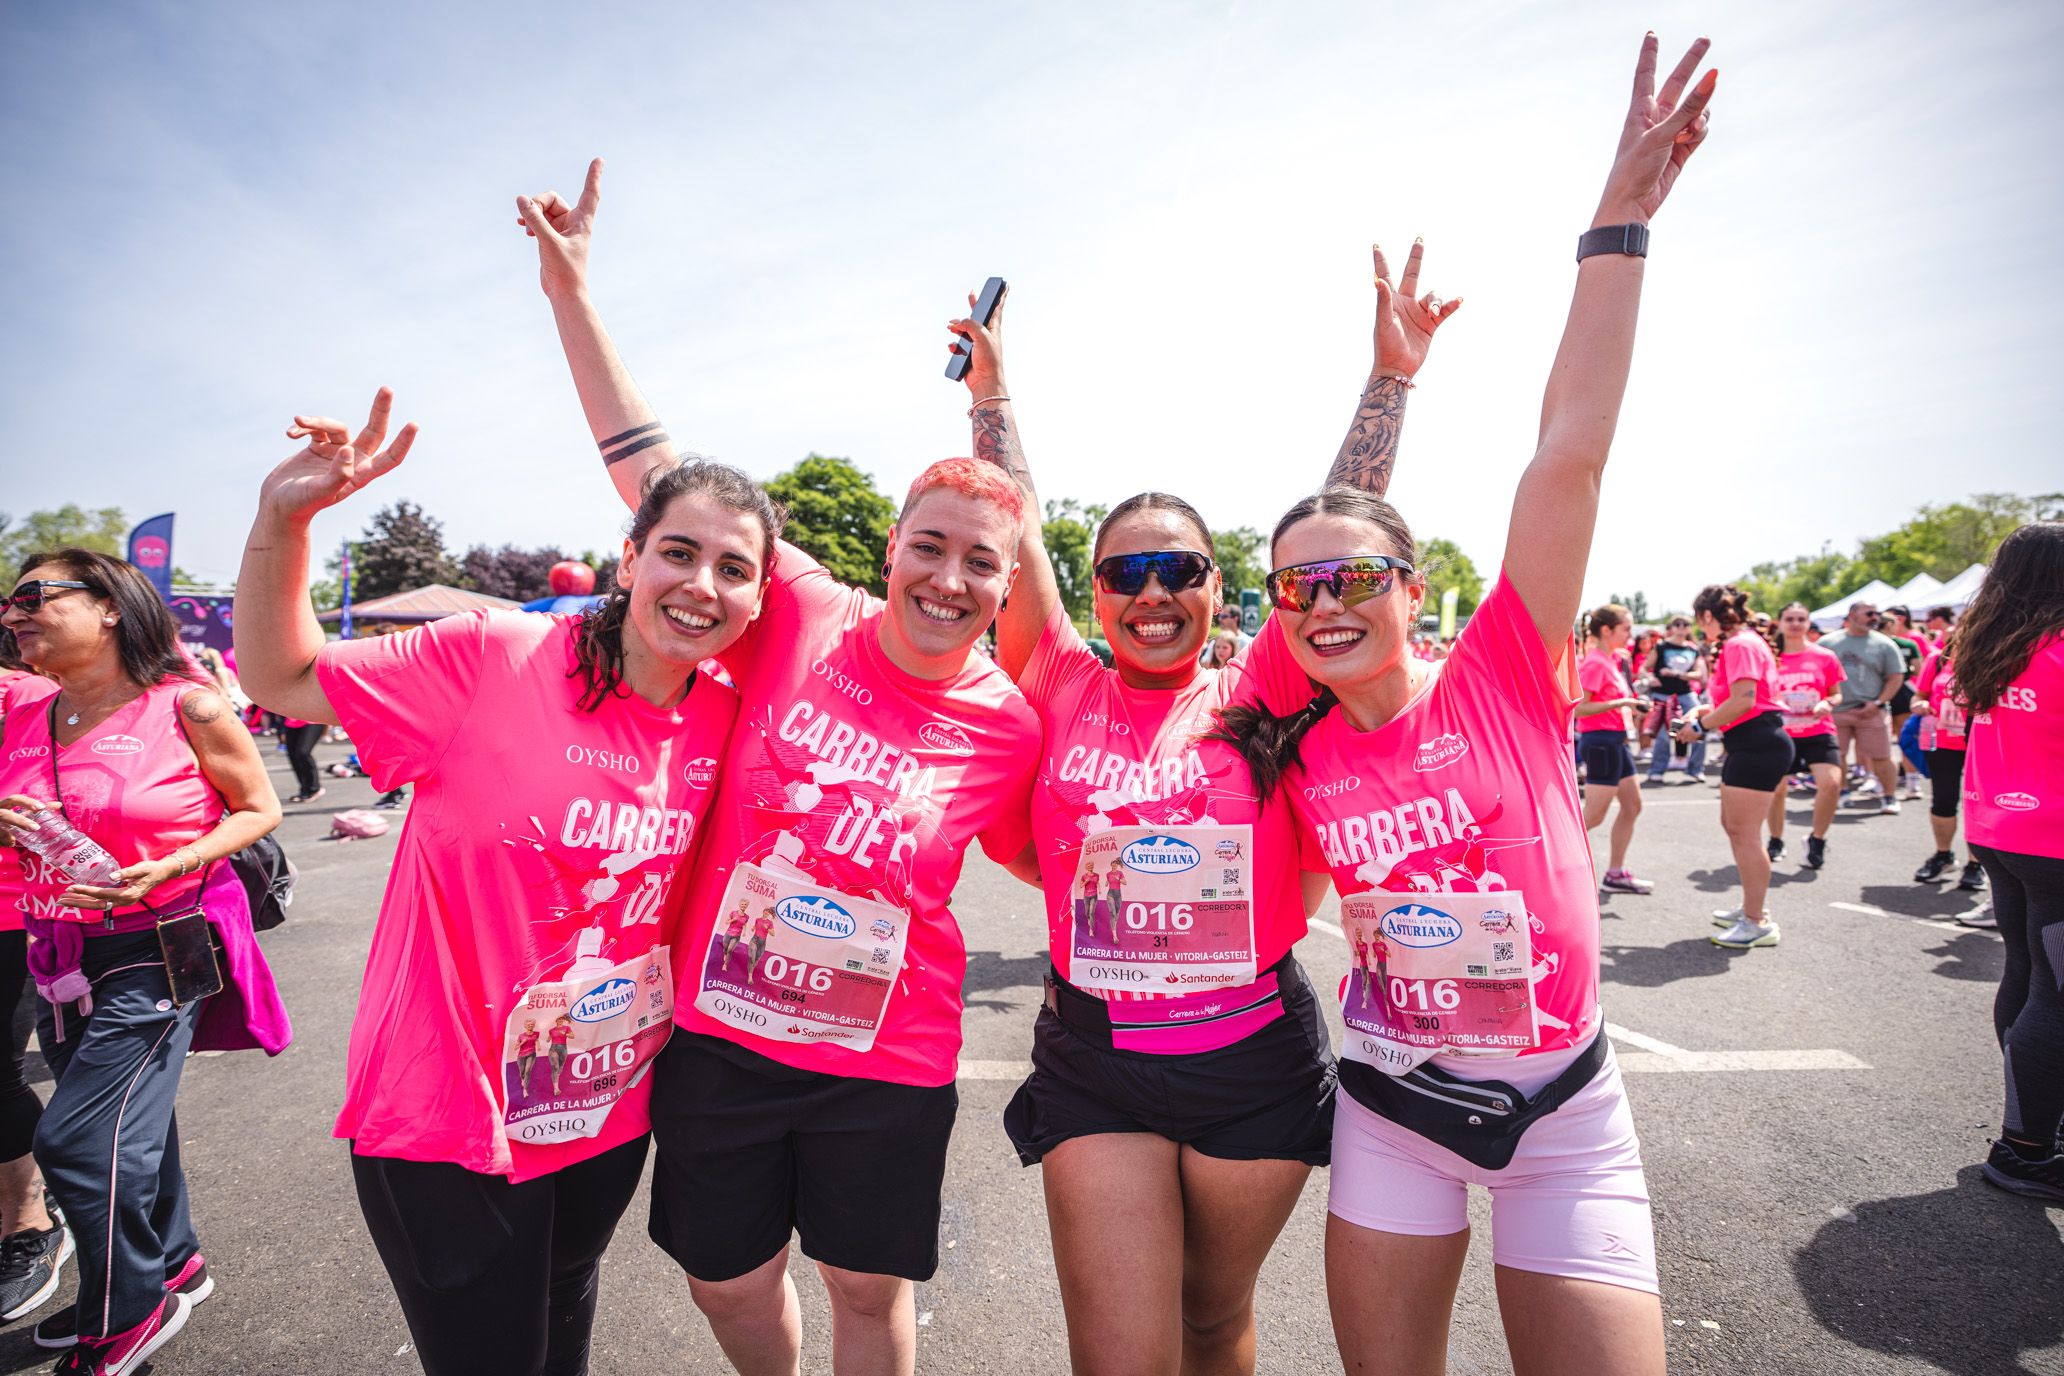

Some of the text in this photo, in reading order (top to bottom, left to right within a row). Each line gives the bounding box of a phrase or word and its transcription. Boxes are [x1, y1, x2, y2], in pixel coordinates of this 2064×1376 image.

[812, 658, 873, 706] OYSHO
[566, 744, 640, 774] OYSHO
[1085, 842, 1118, 856] SUMA
[1127, 849, 1194, 864] ASTURIANA
[745, 880, 776, 900] SUMA
[755, 876, 779, 890] DORSAL
[780, 902, 849, 934] ASTURIANA
[1126, 902, 1194, 930] 016
[1350, 910, 1377, 920] SUMA
[1388, 919, 1455, 937] ASTURIANA
[1154, 936, 1168, 947] 31
[1077, 947, 1111, 958] CARRERA
[1138, 952, 1168, 961] MUJER
[1175, 950, 1248, 961] VITORIA-GASTEIZ
[764, 955, 834, 992] 016
[1090, 966, 1144, 982] OYSHO
[1180, 974, 1235, 984] Santander
[1390, 978, 1460, 1010] 016
[1465, 982, 1526, 990] CORREDORA
[527, 998, 567, 1010] SUMA
[577, 990, 634, 1018] ASTURIANA
[706, 980, 874, 1028] CARRERA DE LA MUJER VITORIA-GASTEIZ
[782, 990, 806, 1004] 694
[714, 998, 767, 1027] OYSHO
[1169, 1009, 1194, 1018] Carrera
[1347, 1018, 1386, 1035] CARRERA
[1388, 1028, 1396, 1038] DE
[1398, 1031, 1407, 1040] LA
[1406, 1033, 1435, 1045] MUJER
[1414, 1016, 1440, 1030] 300
[801, 1028, 855, 1039] Santander
[571, 1040, 635, 1079] 016
[1362, 1040, 1412, 1067] OYSHO
[594, 1075, 616, 1091] 696
[509, 1093, 611, 1121] CARRERA DE LA MUJER
[522, 1118, 586, 1140] OYSHO
